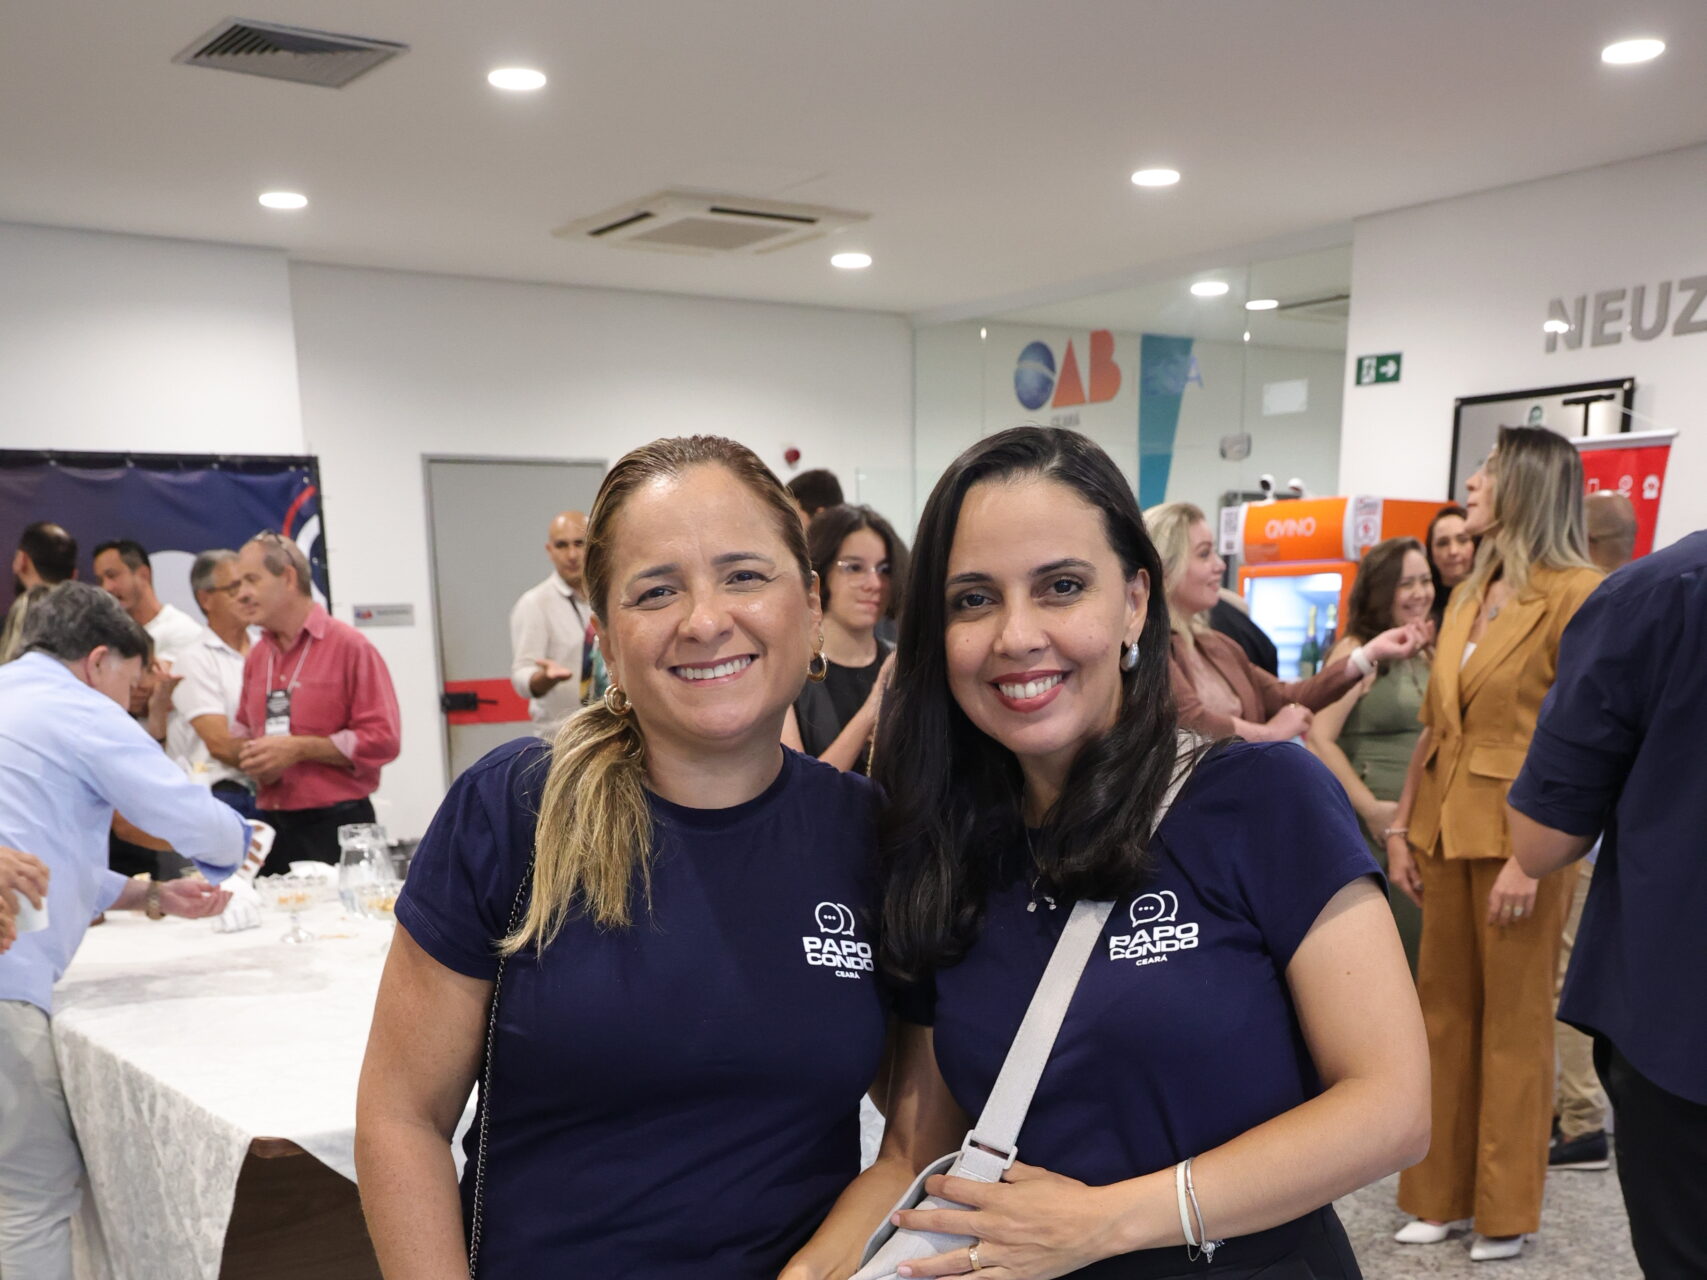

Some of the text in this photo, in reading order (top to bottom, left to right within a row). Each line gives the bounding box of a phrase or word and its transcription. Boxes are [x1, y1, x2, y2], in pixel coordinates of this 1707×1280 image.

[1014, 329, 1121, 411] OAB
[1109, 922, 1199, 949] PAPO
[802, 936, 872, 958] PAPO
[1109, 936, 1199, 961] CONDO
[806, 952, 874, 972] CONDO
[1135, 953, 1168, 967] CEARÁ
[835, 970, 860, 979] CEARÁ
